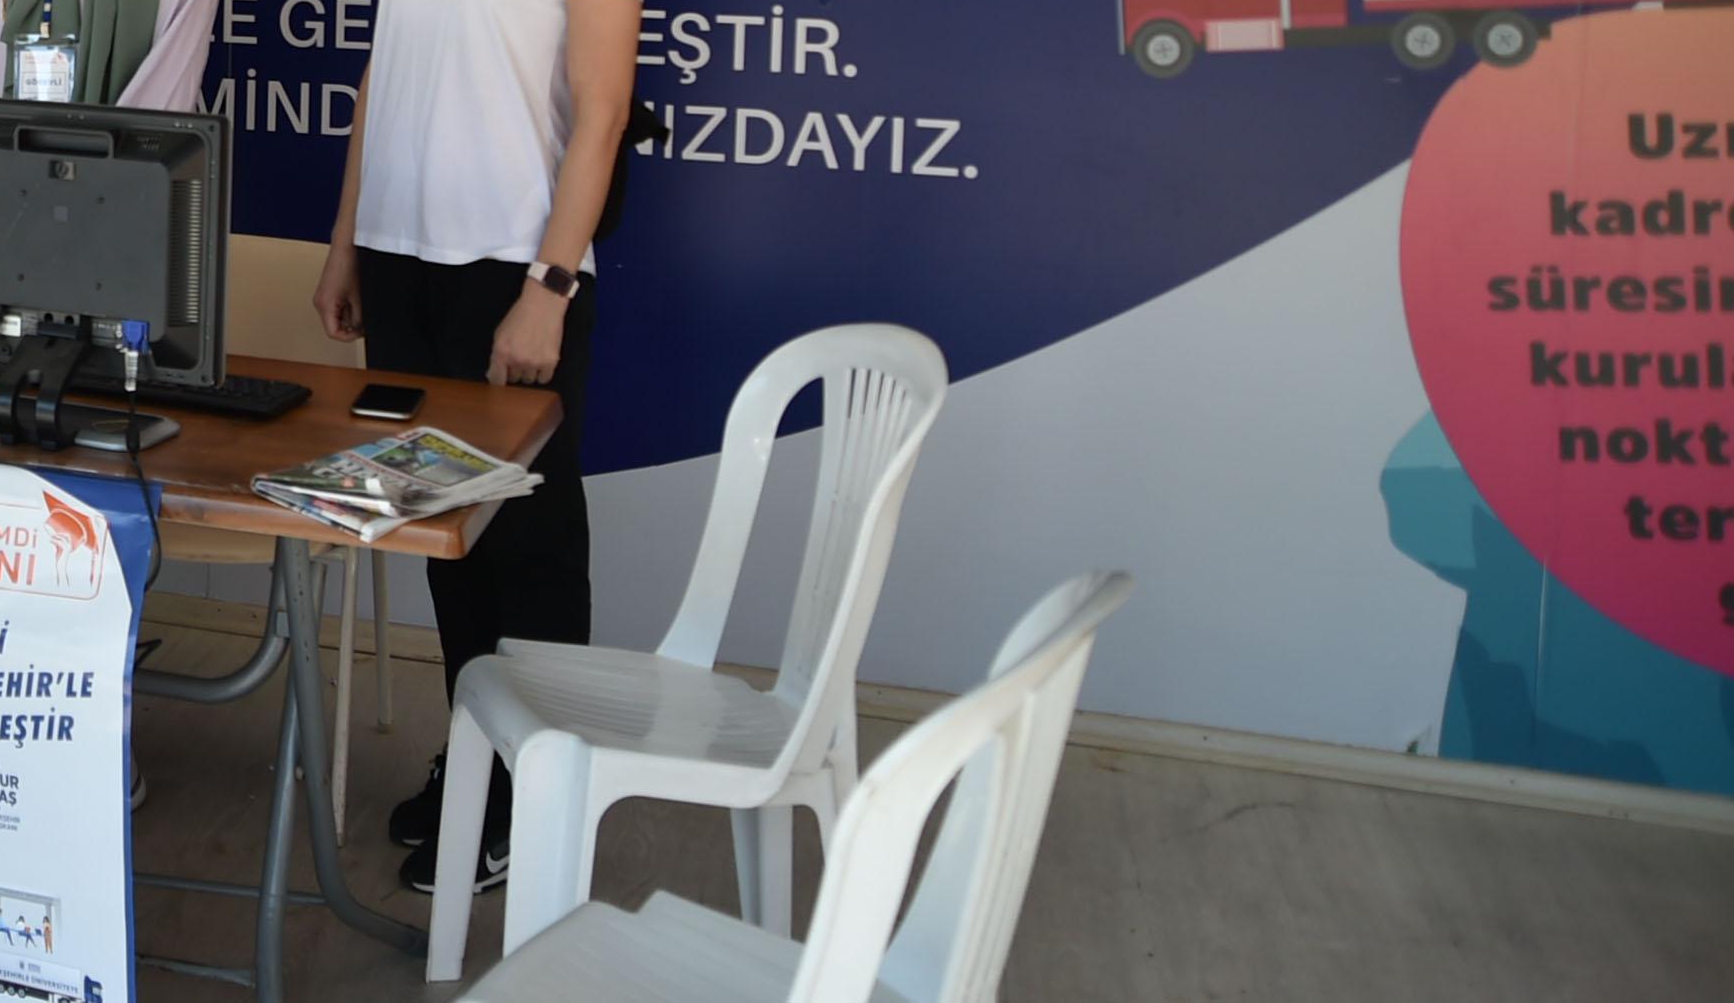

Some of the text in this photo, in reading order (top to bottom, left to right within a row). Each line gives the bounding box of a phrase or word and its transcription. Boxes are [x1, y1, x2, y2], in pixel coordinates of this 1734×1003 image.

[1627, 112, 1734, 160] Uz
[1548, 191, 1734, 237] kadr
[1530, 342, 1734, 390] kurul
